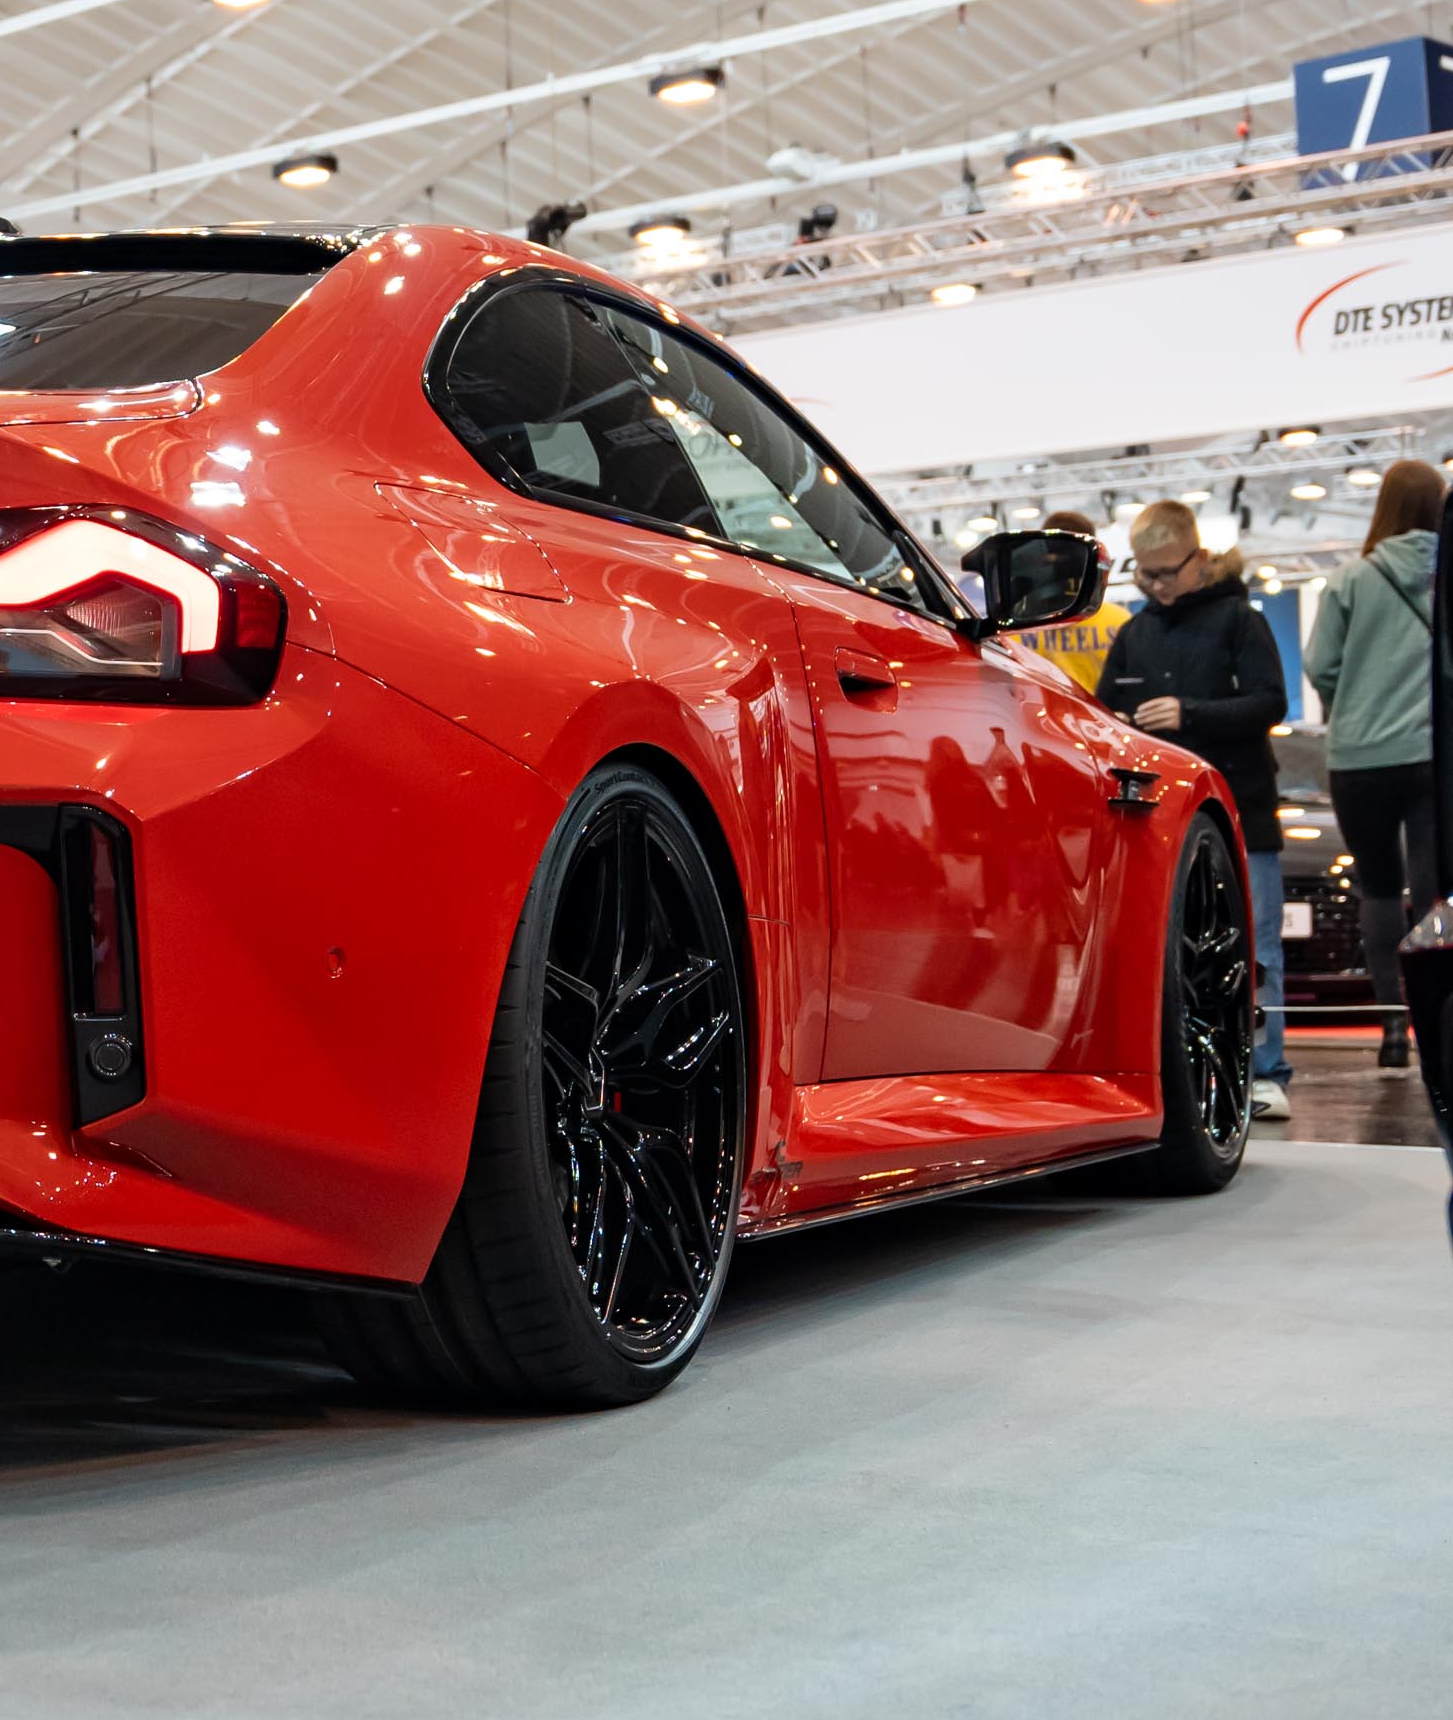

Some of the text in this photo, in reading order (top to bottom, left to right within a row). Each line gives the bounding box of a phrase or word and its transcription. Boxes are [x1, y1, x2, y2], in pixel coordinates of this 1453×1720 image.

[1322, 55, 1392, 183] 7
[1333, 294, 1453, 335] DTE SYSTE
[1019, 625, 1118, 653] WHEELS
